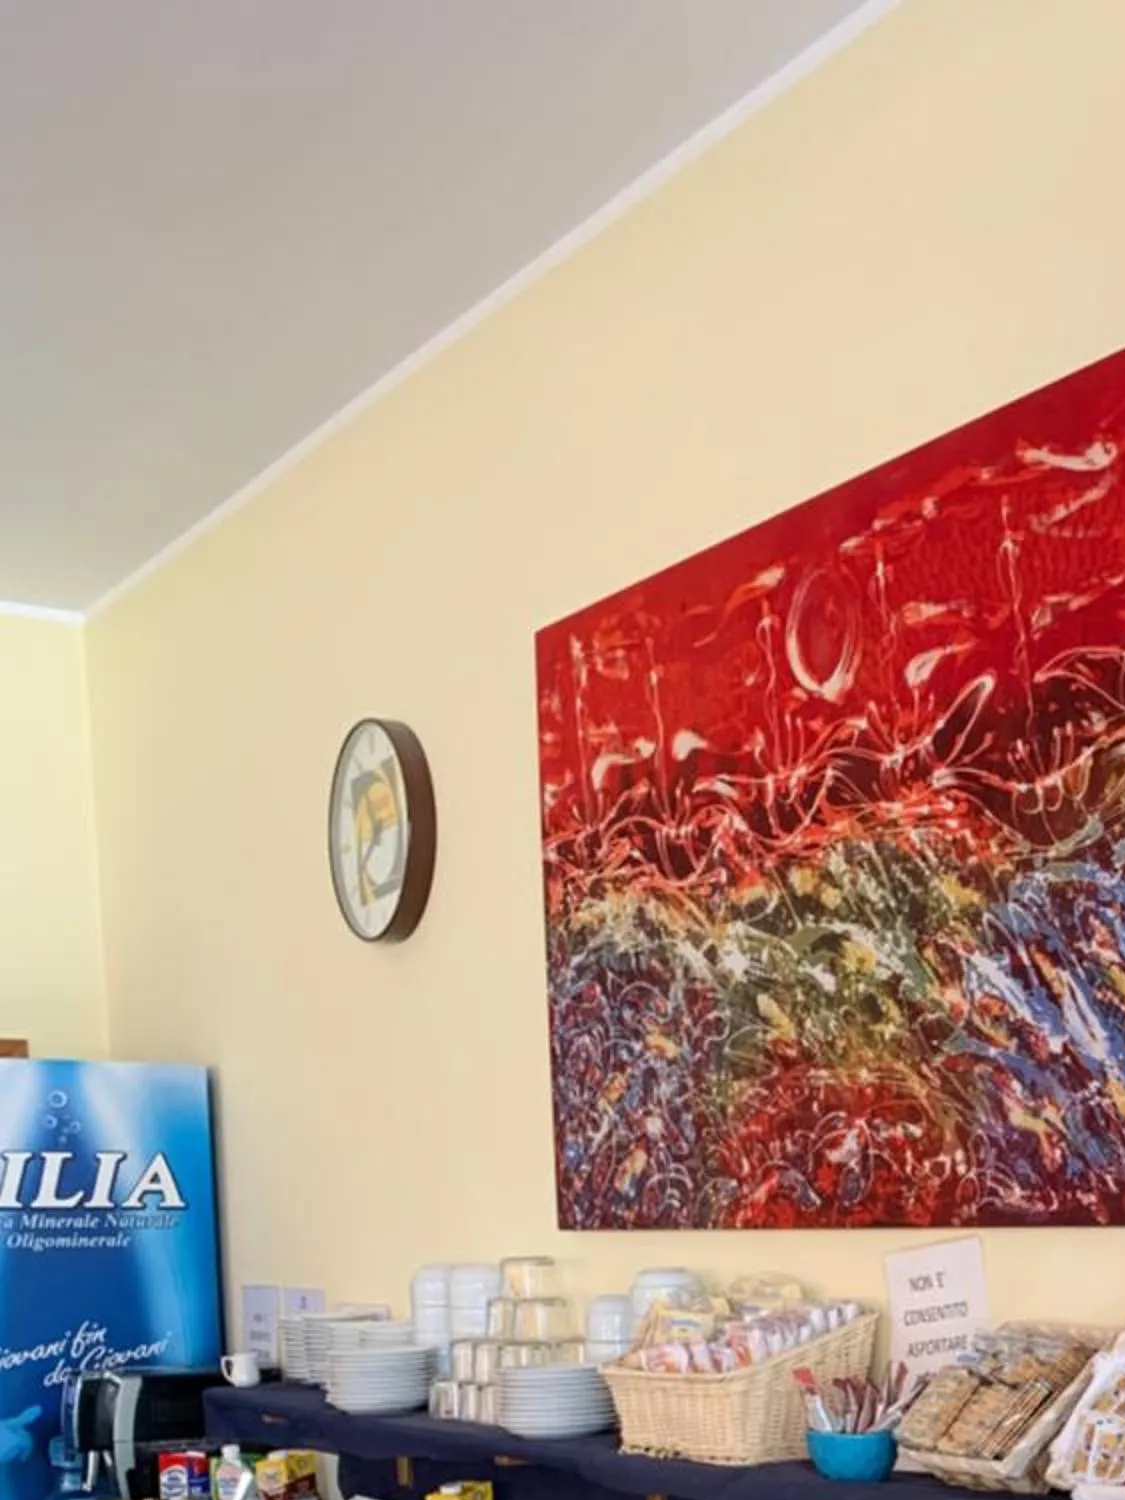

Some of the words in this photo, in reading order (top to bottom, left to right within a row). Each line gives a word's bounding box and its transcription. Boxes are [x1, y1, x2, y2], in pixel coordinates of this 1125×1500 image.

[0, 1151, 187, 1209] ILIA
[20, 1212, 99, 1230] Minerale
[104, 1212, 178, 1230] Naturale
[6, 1231, 131, 1251] Oligominerale
[908, 1274, 933, 1292] NON
[903, 1300, 968, 1327] CONSENTITO
[907, 1333, 967, 1358] ASPORTARE
